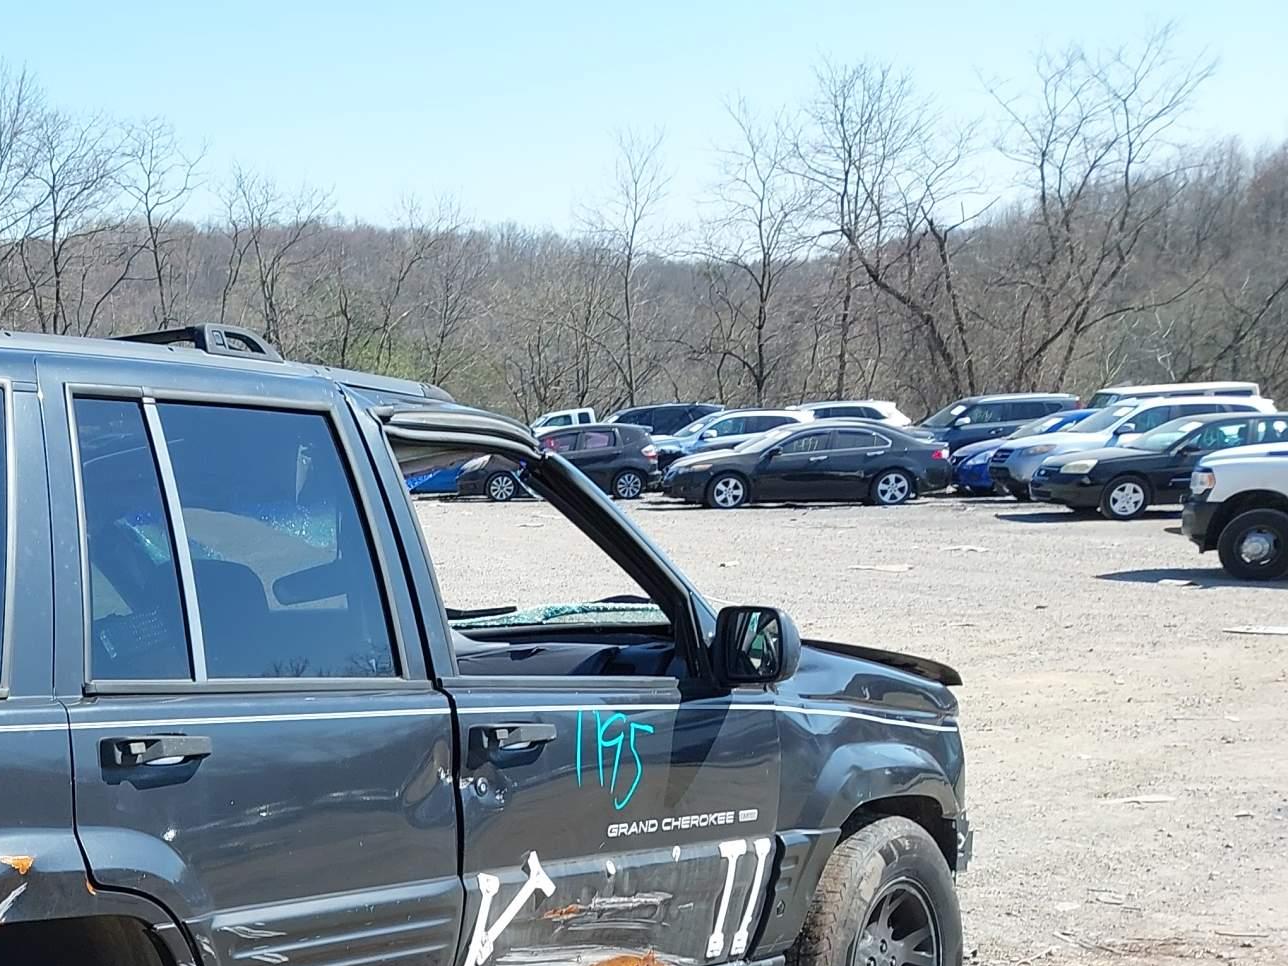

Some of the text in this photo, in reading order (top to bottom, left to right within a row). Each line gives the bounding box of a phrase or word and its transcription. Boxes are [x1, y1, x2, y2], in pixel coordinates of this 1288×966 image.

[576, 707, 654, 810] 1195
[607, 819, 658, 838] GRAND
[661, 811, 735, 831] CHEROKEE
